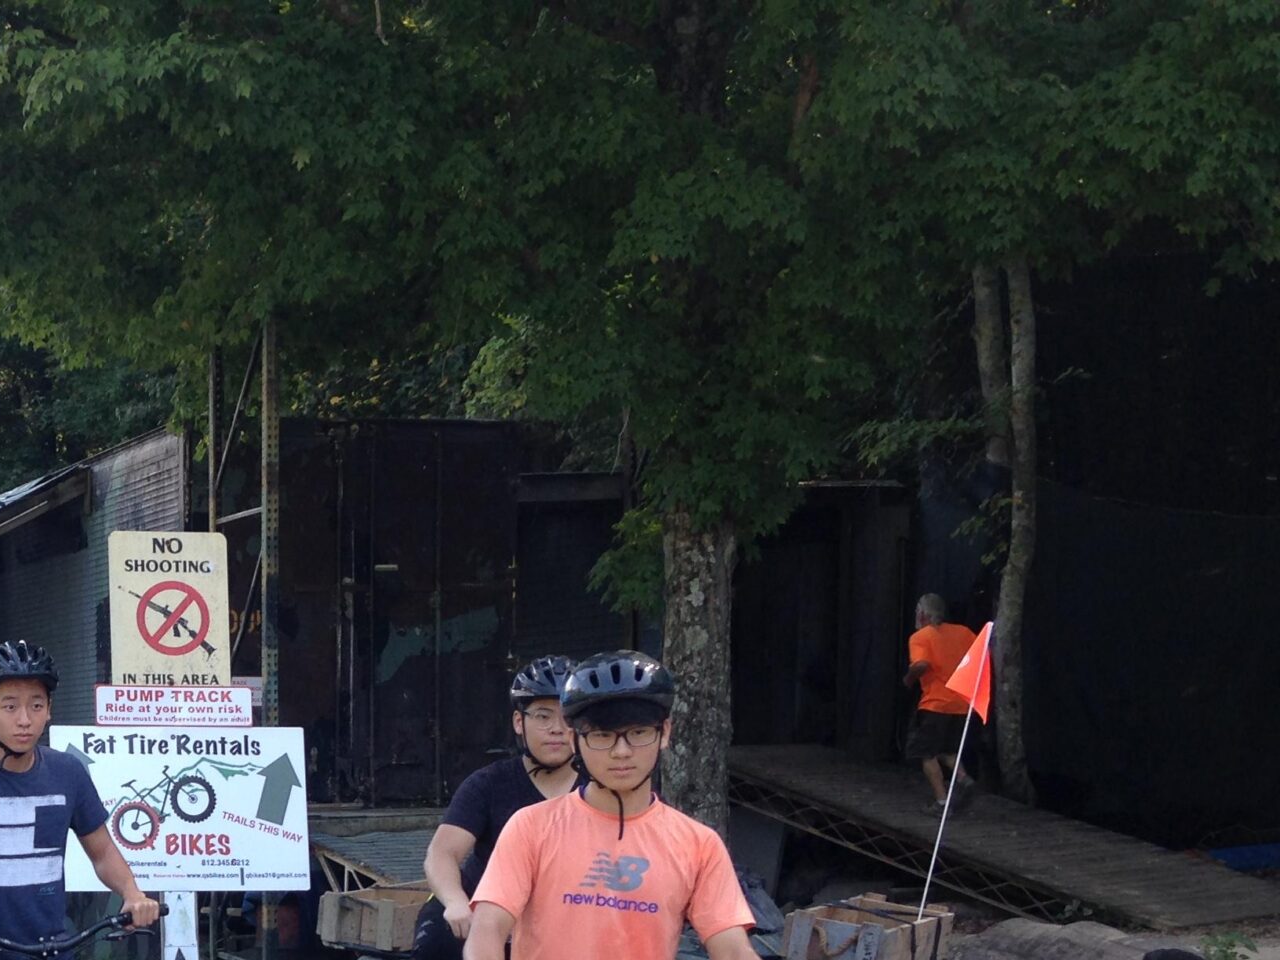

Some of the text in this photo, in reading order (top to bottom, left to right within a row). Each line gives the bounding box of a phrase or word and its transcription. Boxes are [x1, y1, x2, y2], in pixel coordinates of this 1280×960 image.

[152, 537, 183, 554] NO
[124, 559, 211, 573] SHOOTING
[122, 673, 220, 686] IN THIS AREA
[115, 689, 232, 703] PUMP TRACK
[105, 703, 133, 713] Ride
[138, 704, 150, 713] at
[155, 706, 182, 715] your
[219, 704, 242, 713] risk
[165, 715, 207, 723] supervised
[83, 732, 261, 755] Fat Tire Rentals
[222, 811, 303, 843] TRAILS THIS WAY
[165, 833, 231, 856] BIKES
[562, 893, 659, 914] new balance
